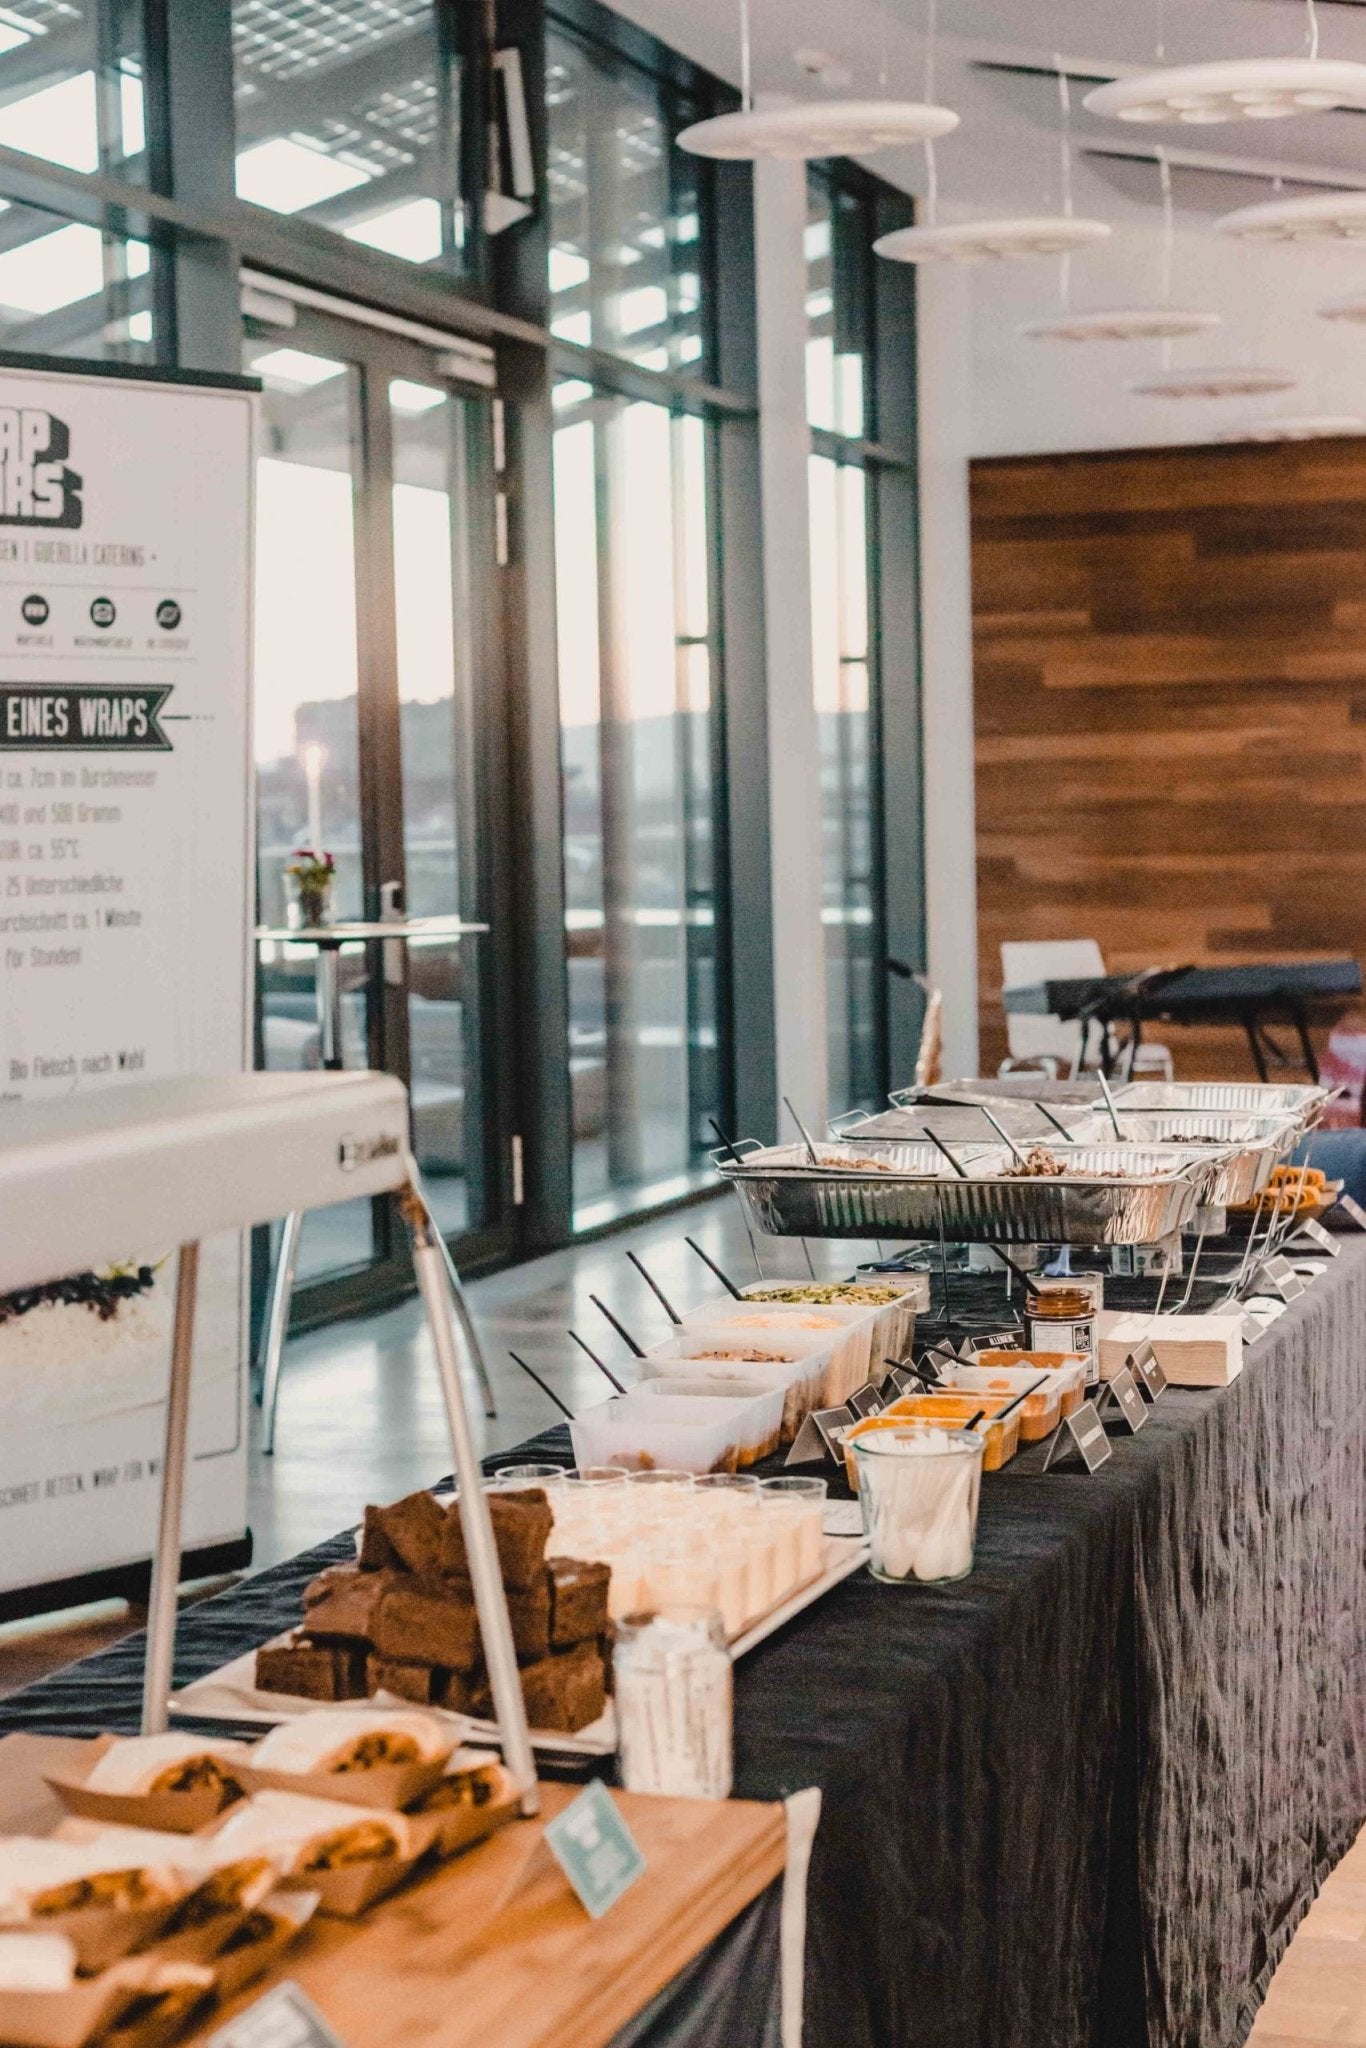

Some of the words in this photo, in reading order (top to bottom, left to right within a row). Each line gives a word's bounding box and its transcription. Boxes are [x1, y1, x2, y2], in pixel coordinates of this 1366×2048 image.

[34, 541, 88, 564] GUERILLA
[93, 543, 145, 567] CATERING
[7, 697, 69, 737] EINES
[79, 697, 149, 738] WRAPS
[80, 766, 158, 788] Durchmesser
[23, 804, 46, 825] und
[77, 801, 122, 824] Gramm
[25, 873, 124, 896] Unterschiedliche
[104, 907, 142, 928] Minute
[33, 1055, 77, 1078] Fleisch
[81, 1052, 112, 1075] nach
